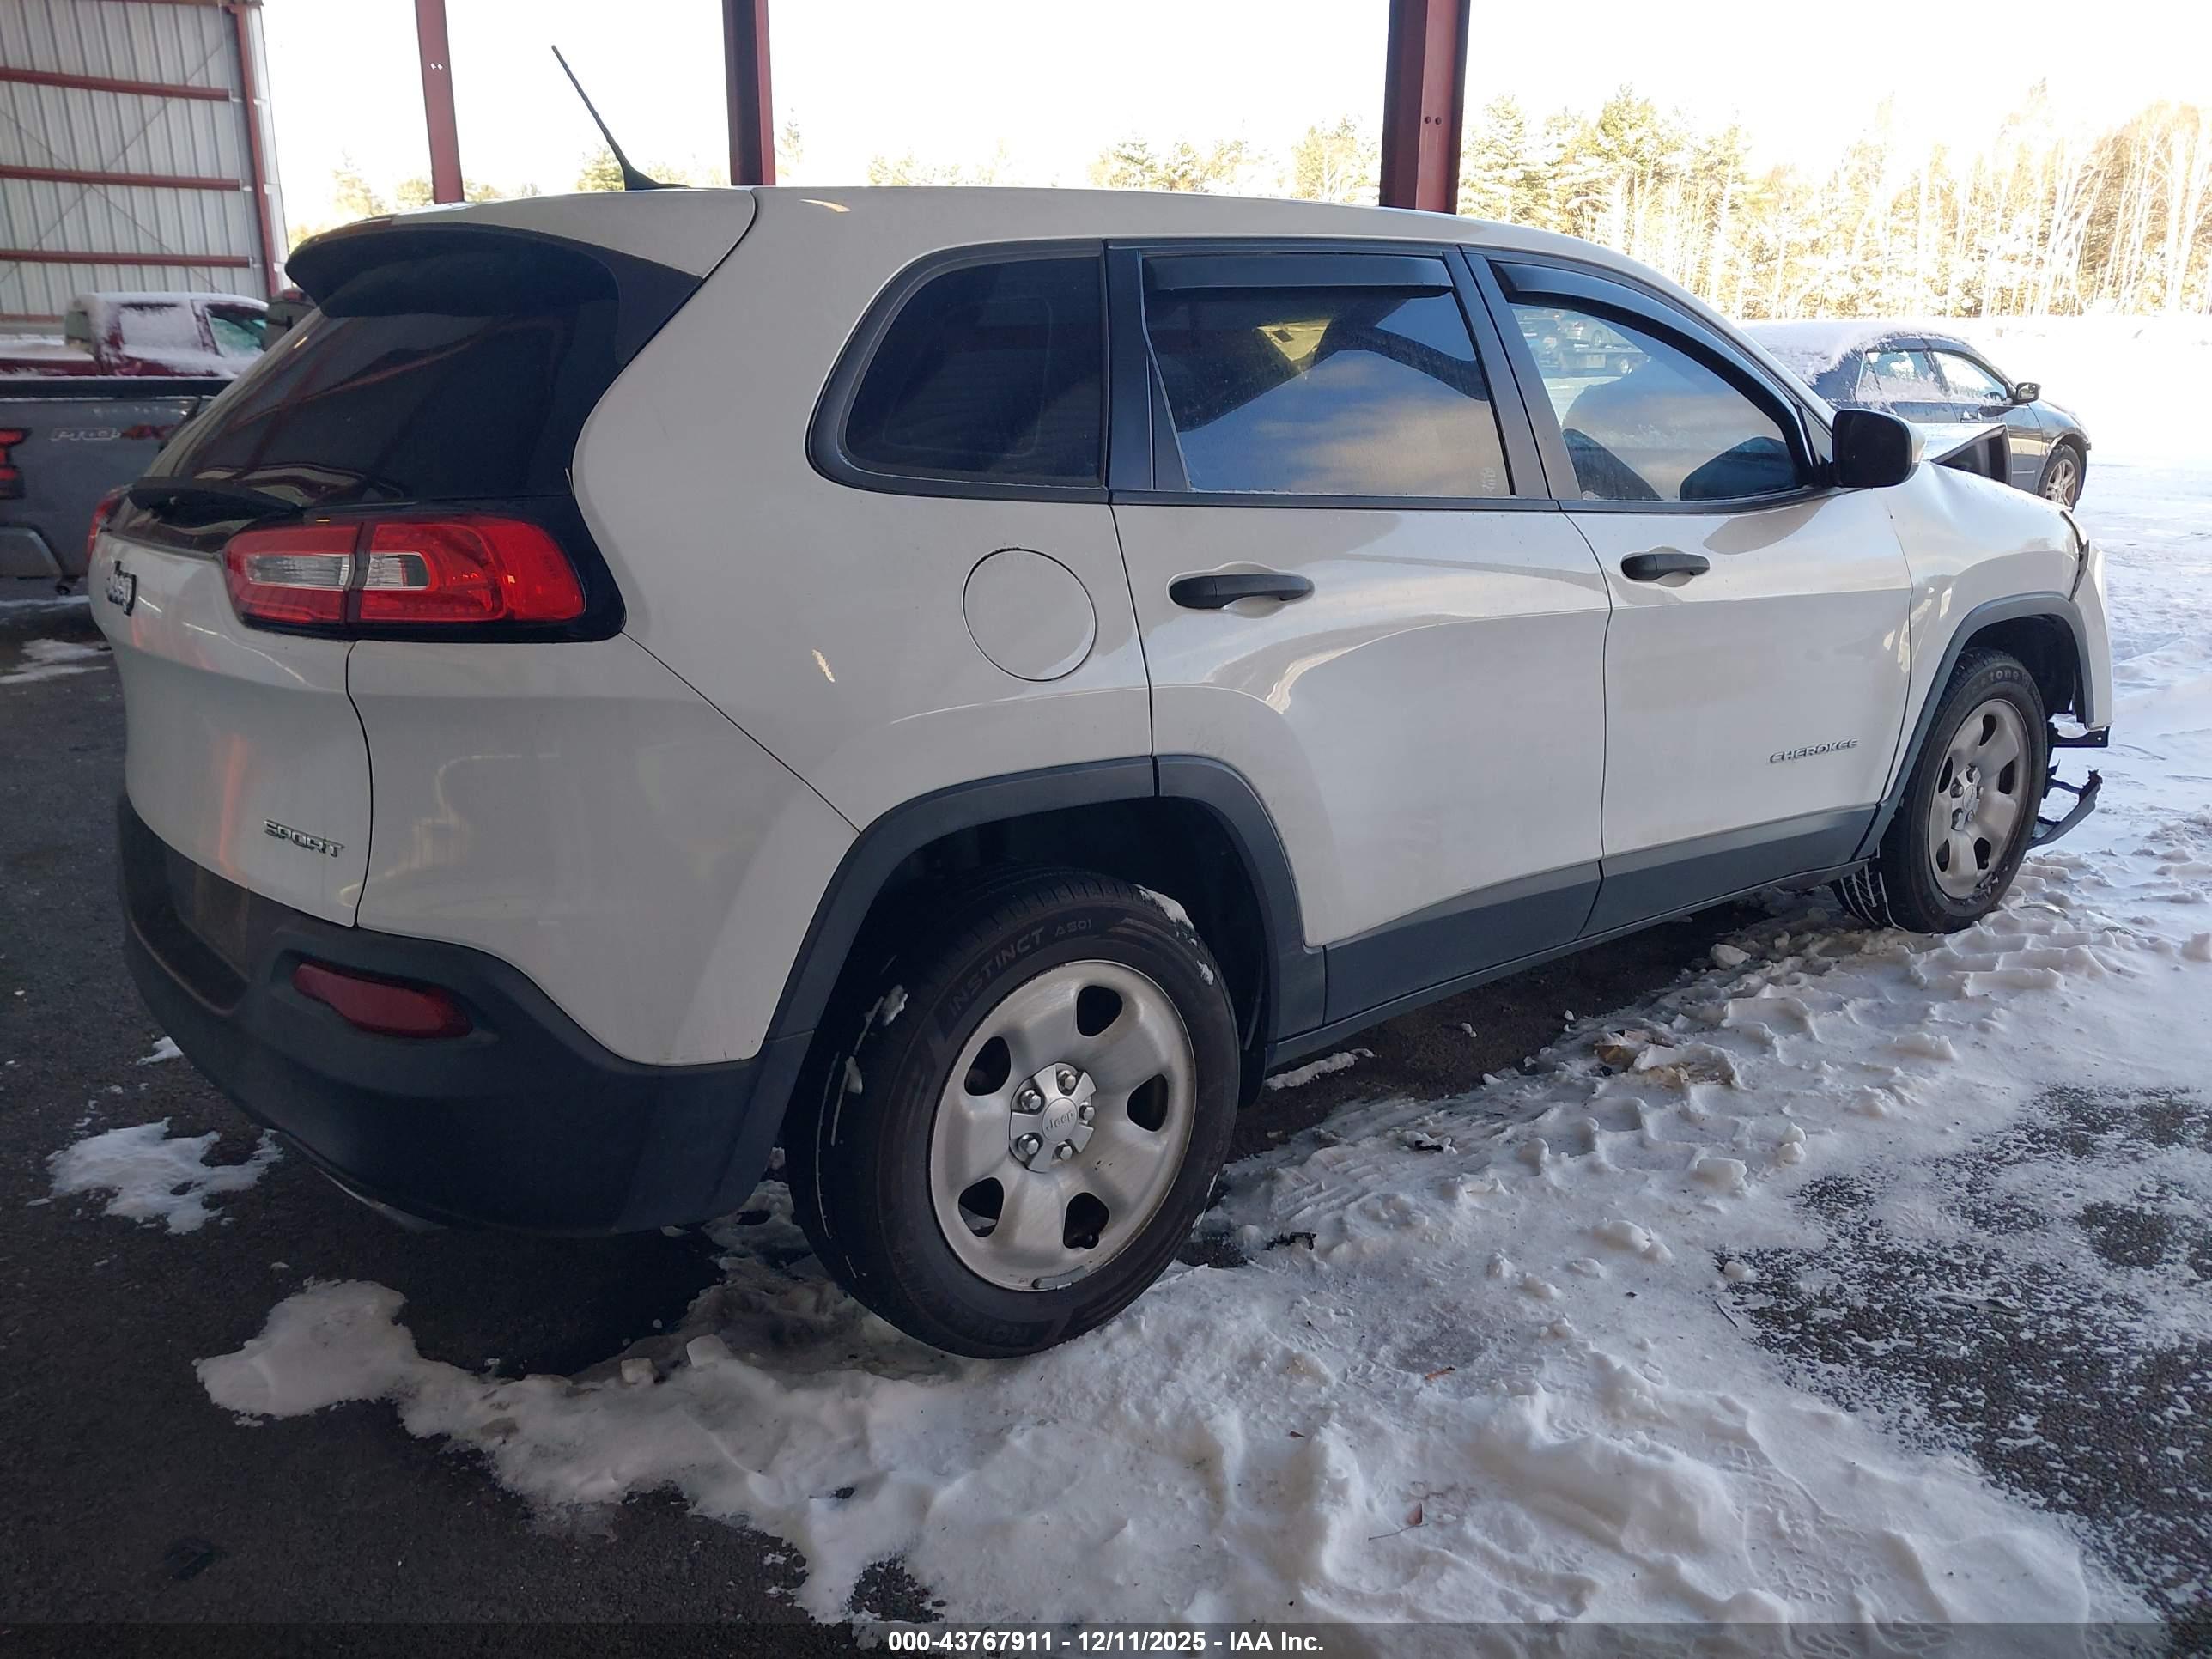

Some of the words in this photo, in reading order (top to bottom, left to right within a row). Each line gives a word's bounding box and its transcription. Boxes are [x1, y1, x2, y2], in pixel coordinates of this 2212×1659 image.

[1769, 738, 1859, 763] CHEROKEE
[264, 818, 345, 858] SPORT
[948, 927, 1045, 1018] INSTINCT
[1045, 1111, 1074, 1132] Jeep
